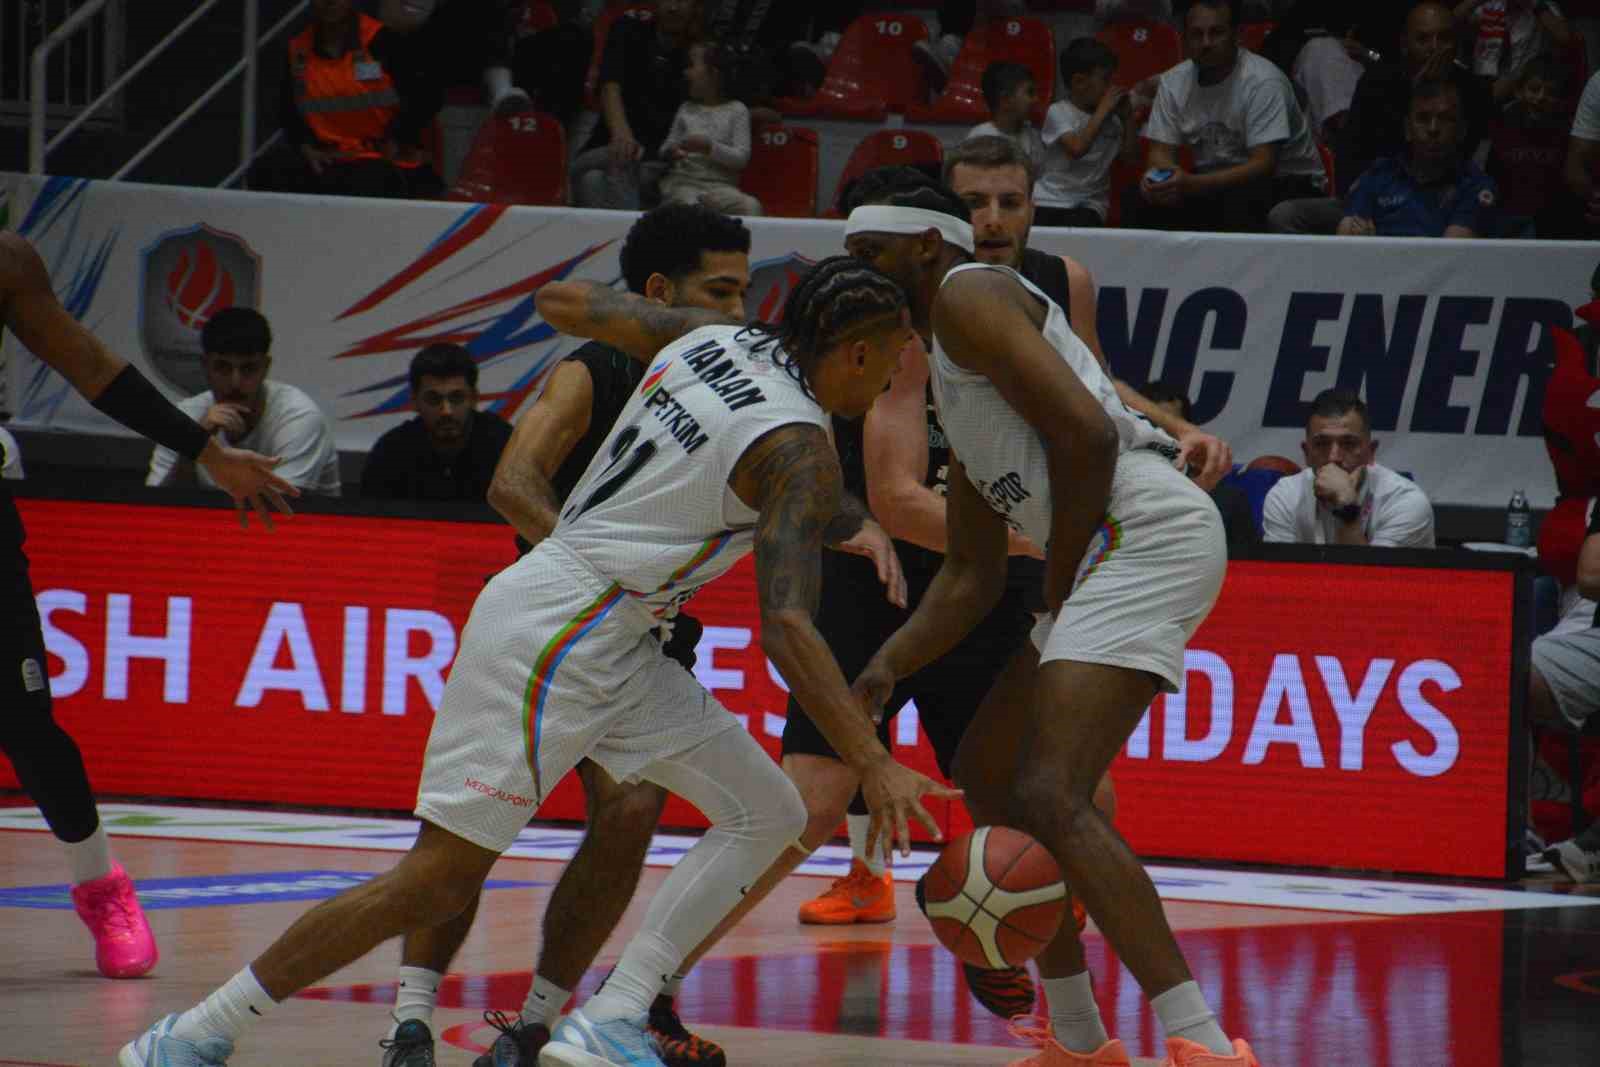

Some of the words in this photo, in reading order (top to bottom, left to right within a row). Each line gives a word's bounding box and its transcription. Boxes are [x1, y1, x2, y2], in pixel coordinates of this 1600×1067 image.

[874, 20, 903, 36] 10
[1006, 21, 1021, 36] 9
[508, 116, 537, 132] 12
[761, 131, 788, 146] 10
[893, 134, 908, 149] 9
